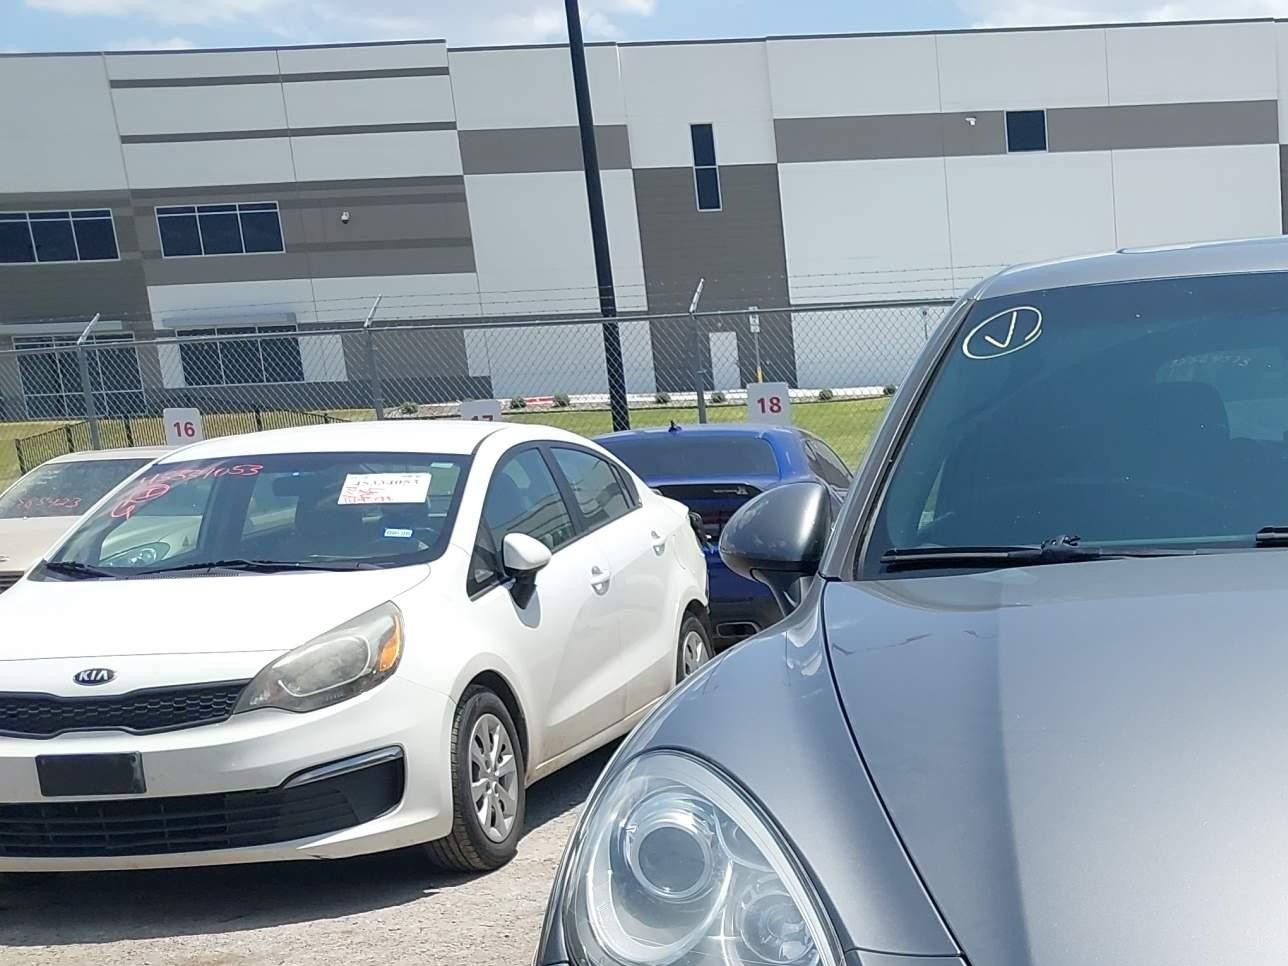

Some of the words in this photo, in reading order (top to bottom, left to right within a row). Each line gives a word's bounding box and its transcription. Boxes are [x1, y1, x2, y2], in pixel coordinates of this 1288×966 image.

[757, 396, 782, 414] 18
[173, 421, 196, 438] 16
[78, 670, 109, 681] KIA
